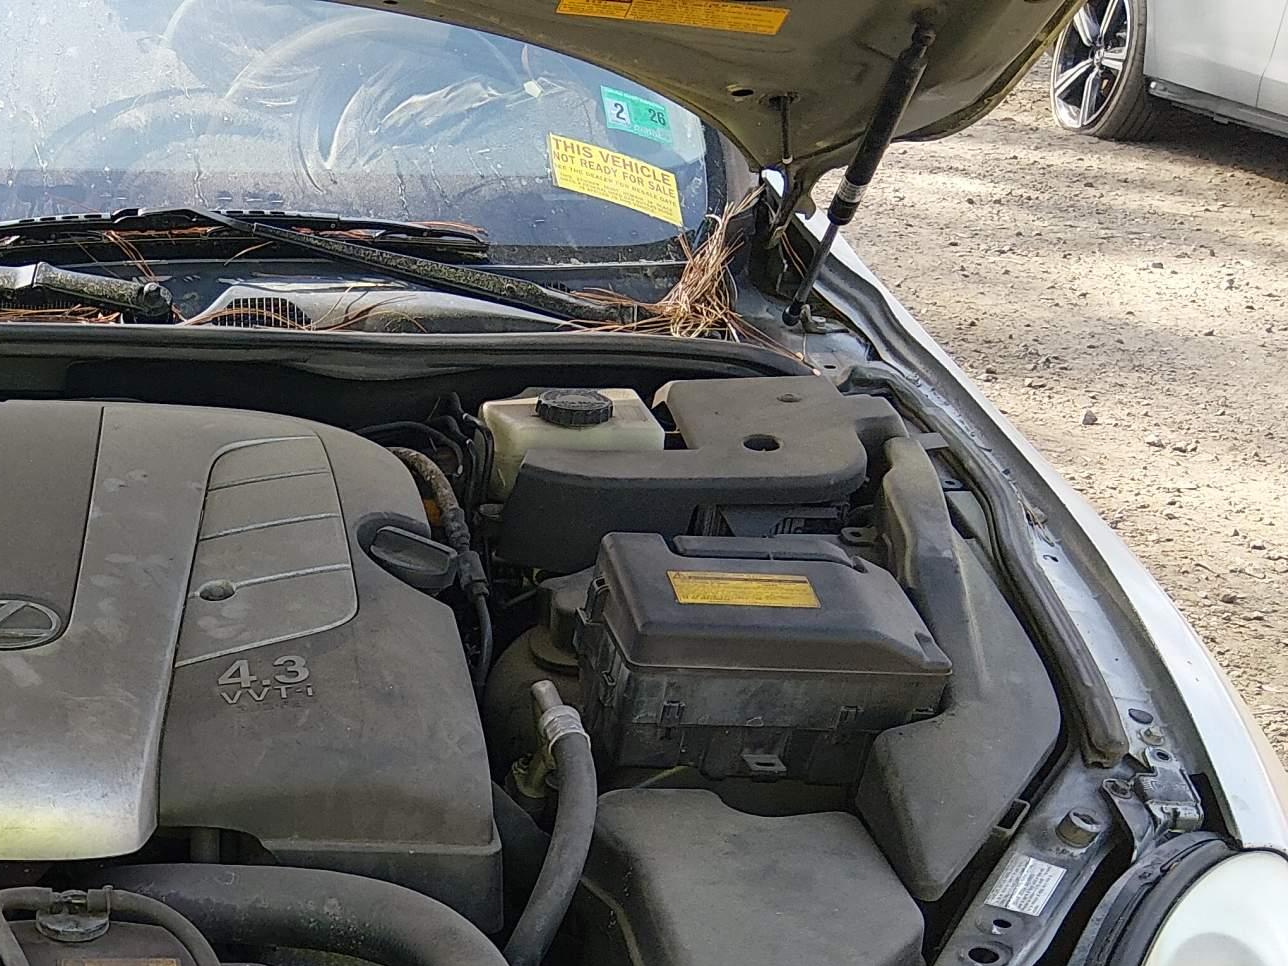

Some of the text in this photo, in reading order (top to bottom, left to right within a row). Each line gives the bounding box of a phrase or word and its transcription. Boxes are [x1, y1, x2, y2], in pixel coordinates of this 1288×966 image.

[614, 103, 666, 126] 2 26
[552, 137, 672, 187] THIS VEHICLE
[553, 151, 575, 165] NOT
[580, 159, 618, 178] READY
[623, 171, 644, 187] FOR
[648, 180, 676, 199] SALE
[217, 655, 311, 689] 4.3
